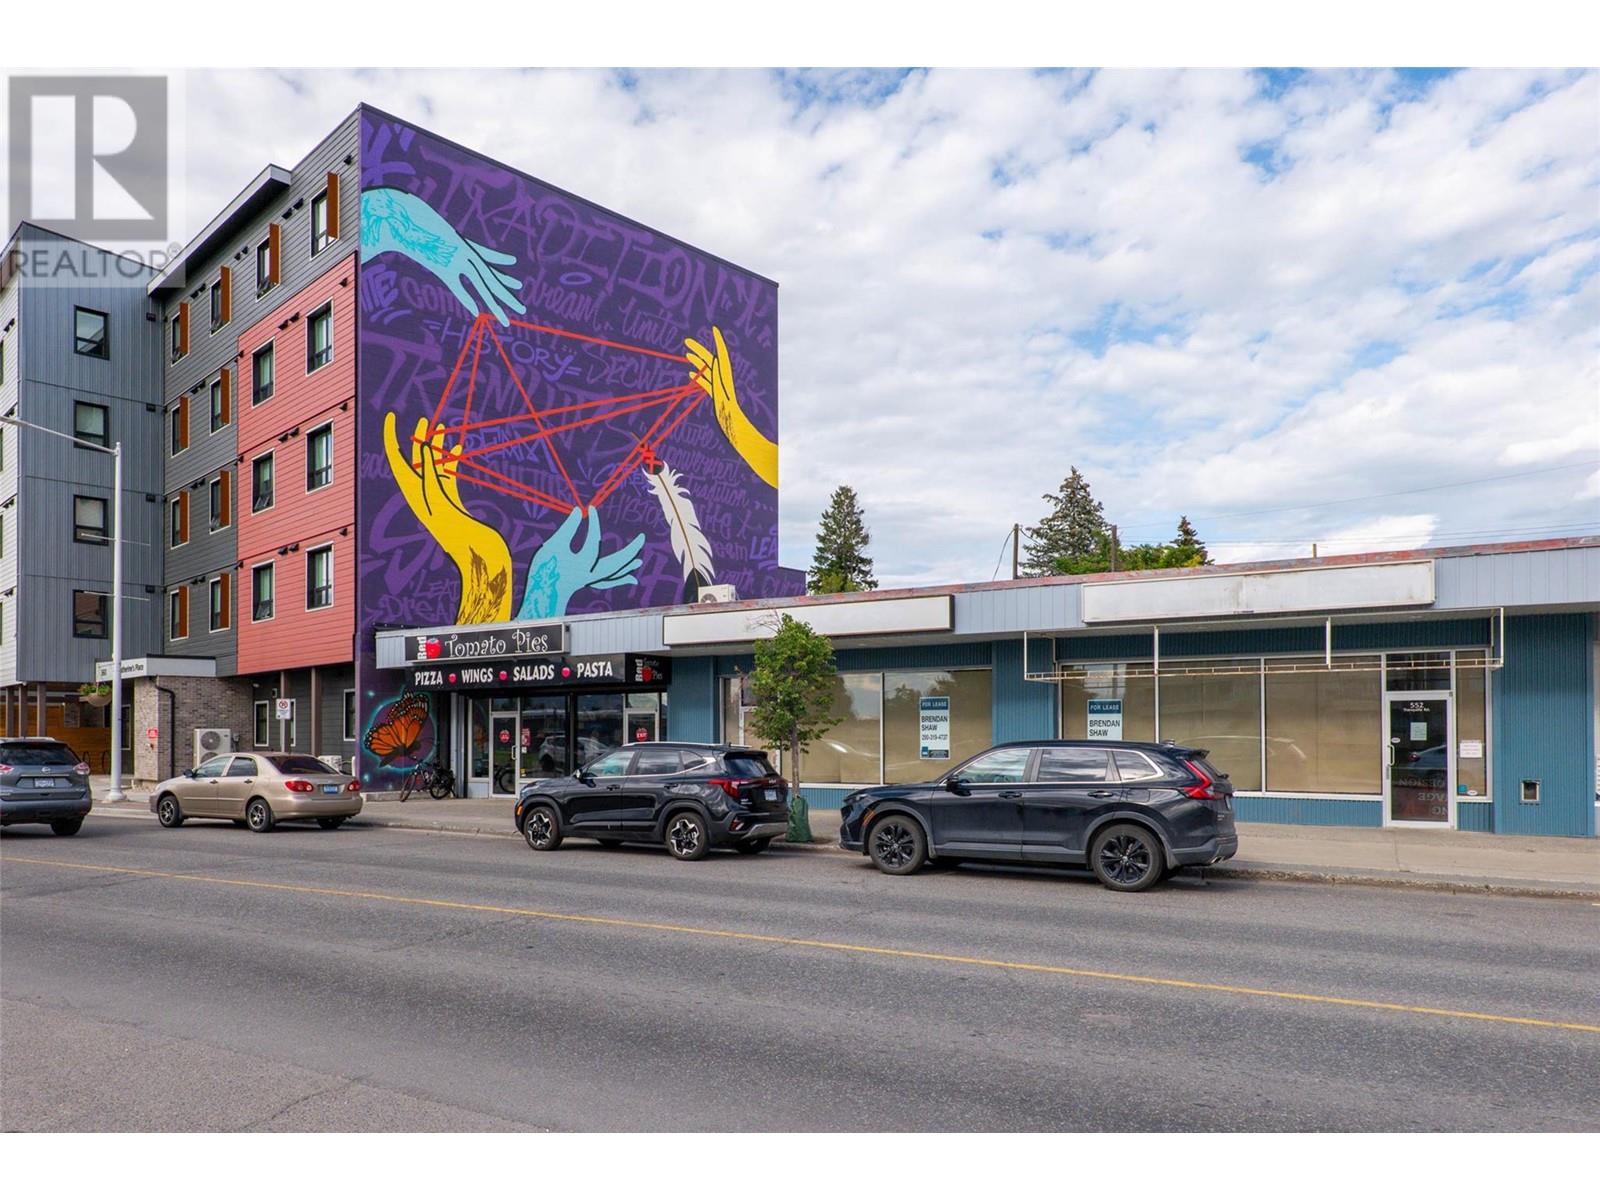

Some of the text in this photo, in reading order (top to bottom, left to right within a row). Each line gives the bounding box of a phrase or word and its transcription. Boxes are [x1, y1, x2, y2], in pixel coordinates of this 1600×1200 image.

[444, 634, 506, 658] Tomato
[511, 627, 549, 654] Pies
[414, 661, 613, 686] PIZZA WINGS SALADS PASTA
[921, 715, 948, 723] BRENDAN
[1089, 719, 1121, 727] BRENDAN
[1089, 729, 1108, 737] SHAW
